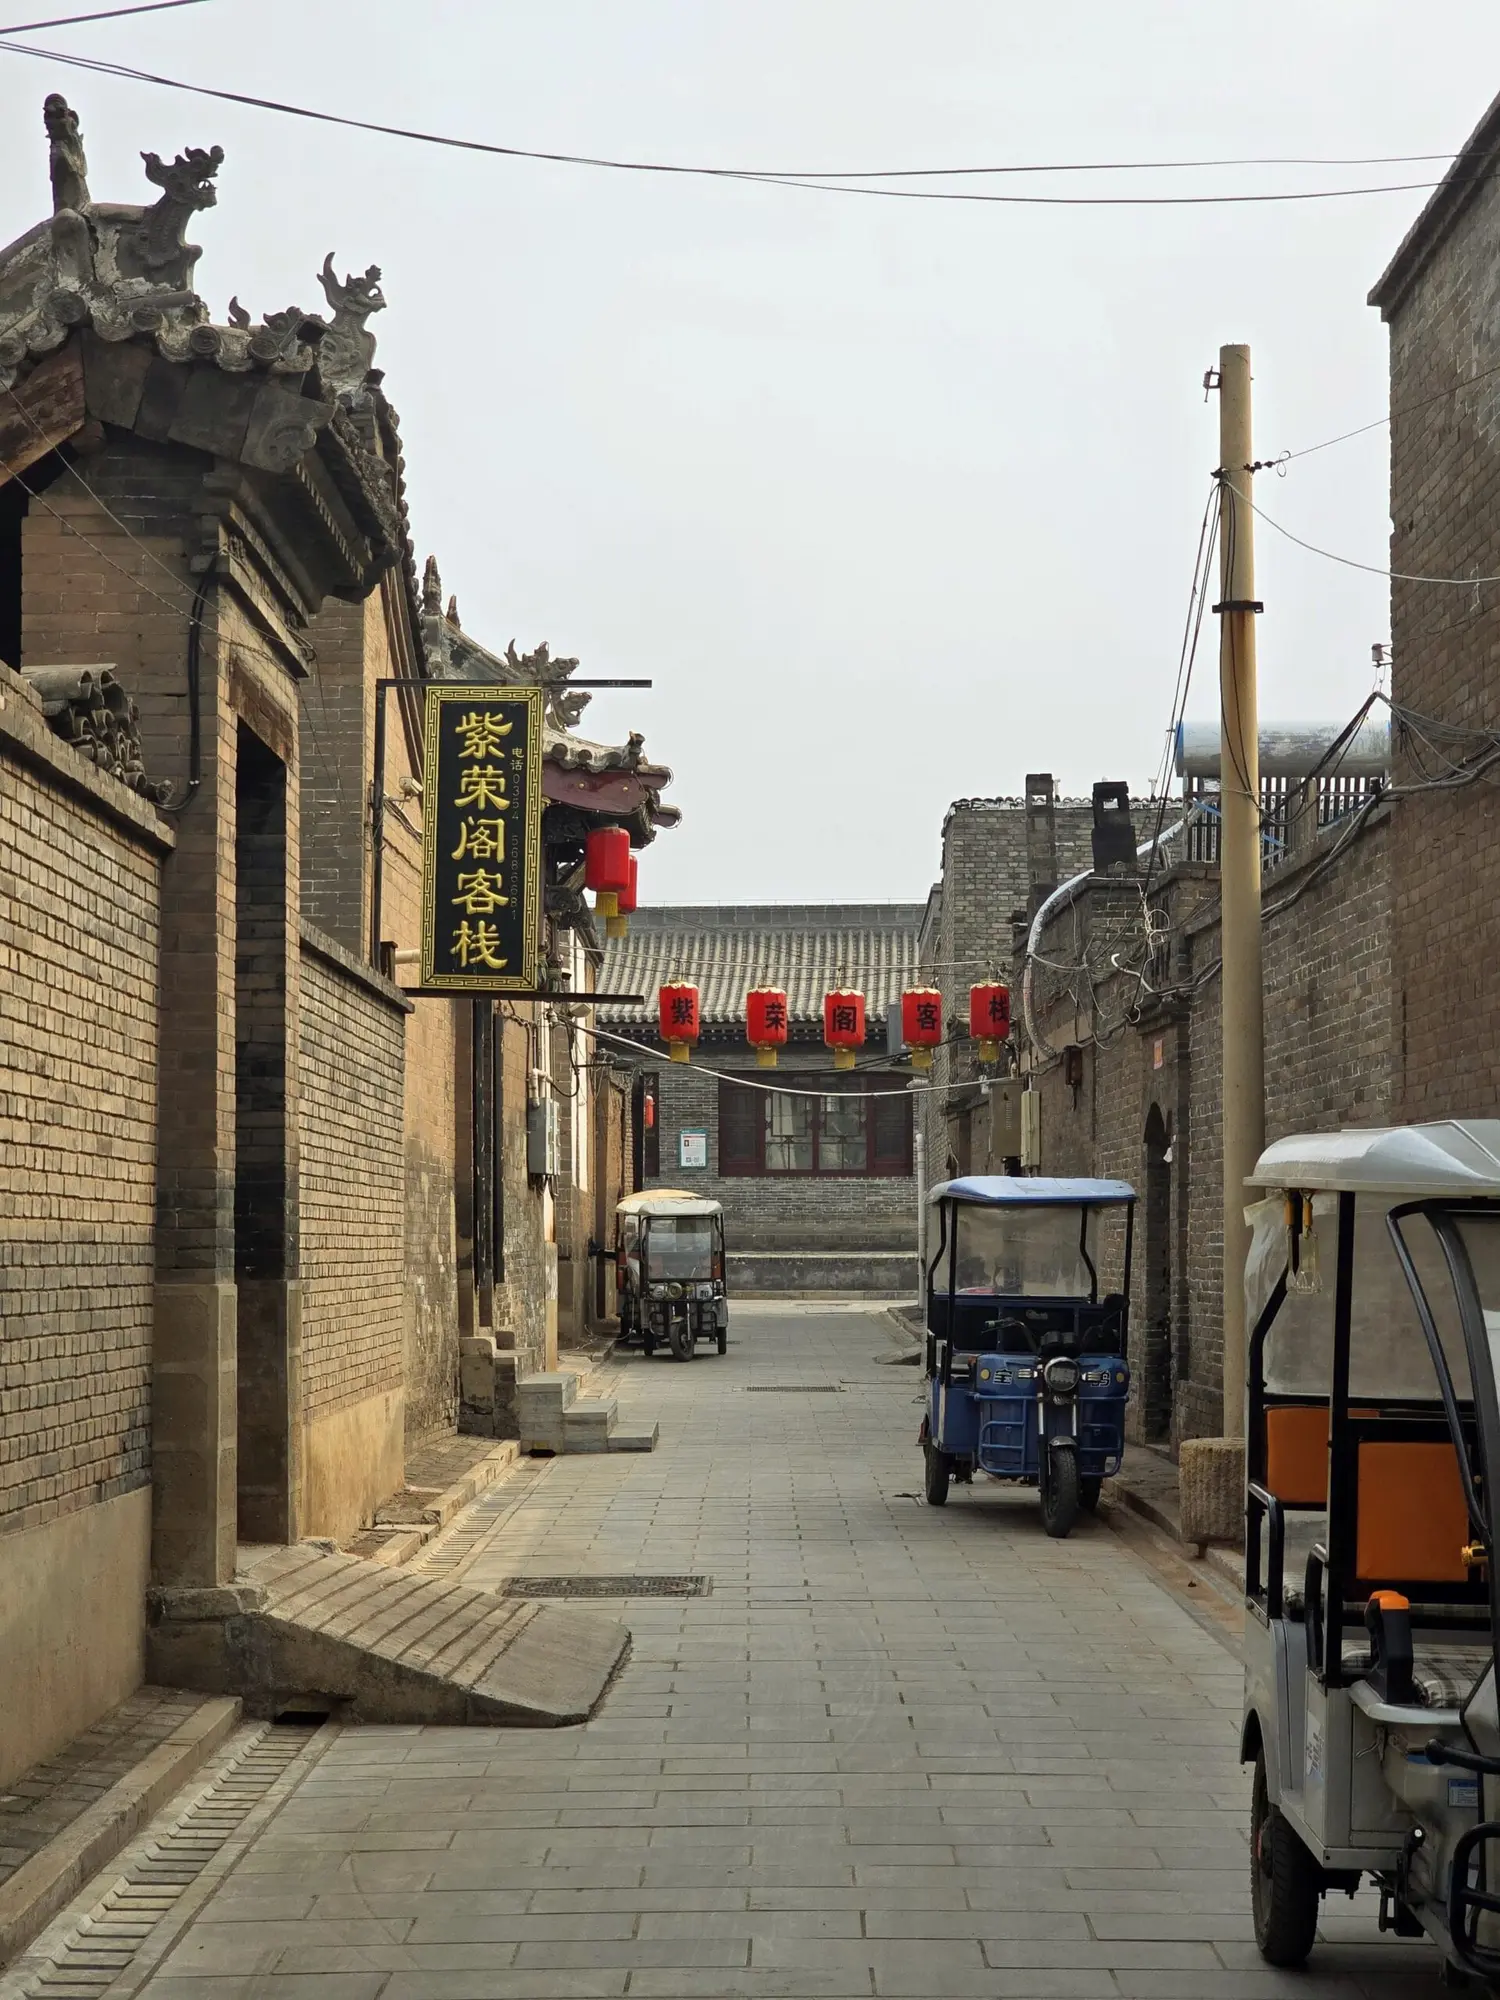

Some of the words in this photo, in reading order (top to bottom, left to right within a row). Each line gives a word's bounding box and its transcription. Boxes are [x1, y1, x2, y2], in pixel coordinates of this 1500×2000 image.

[510, 747, 524, 820] 电话0354
[451, 712, 513, 969] 紫荣阁客栈
[670, 997, 694, 1026] 紫
[764, 1002, 785, 1030] 荣
[832, 1004, 857, 1034] 阁
[916, 1002, 938, 1031] 客
[988, 995, 1010, 1025] 栈
